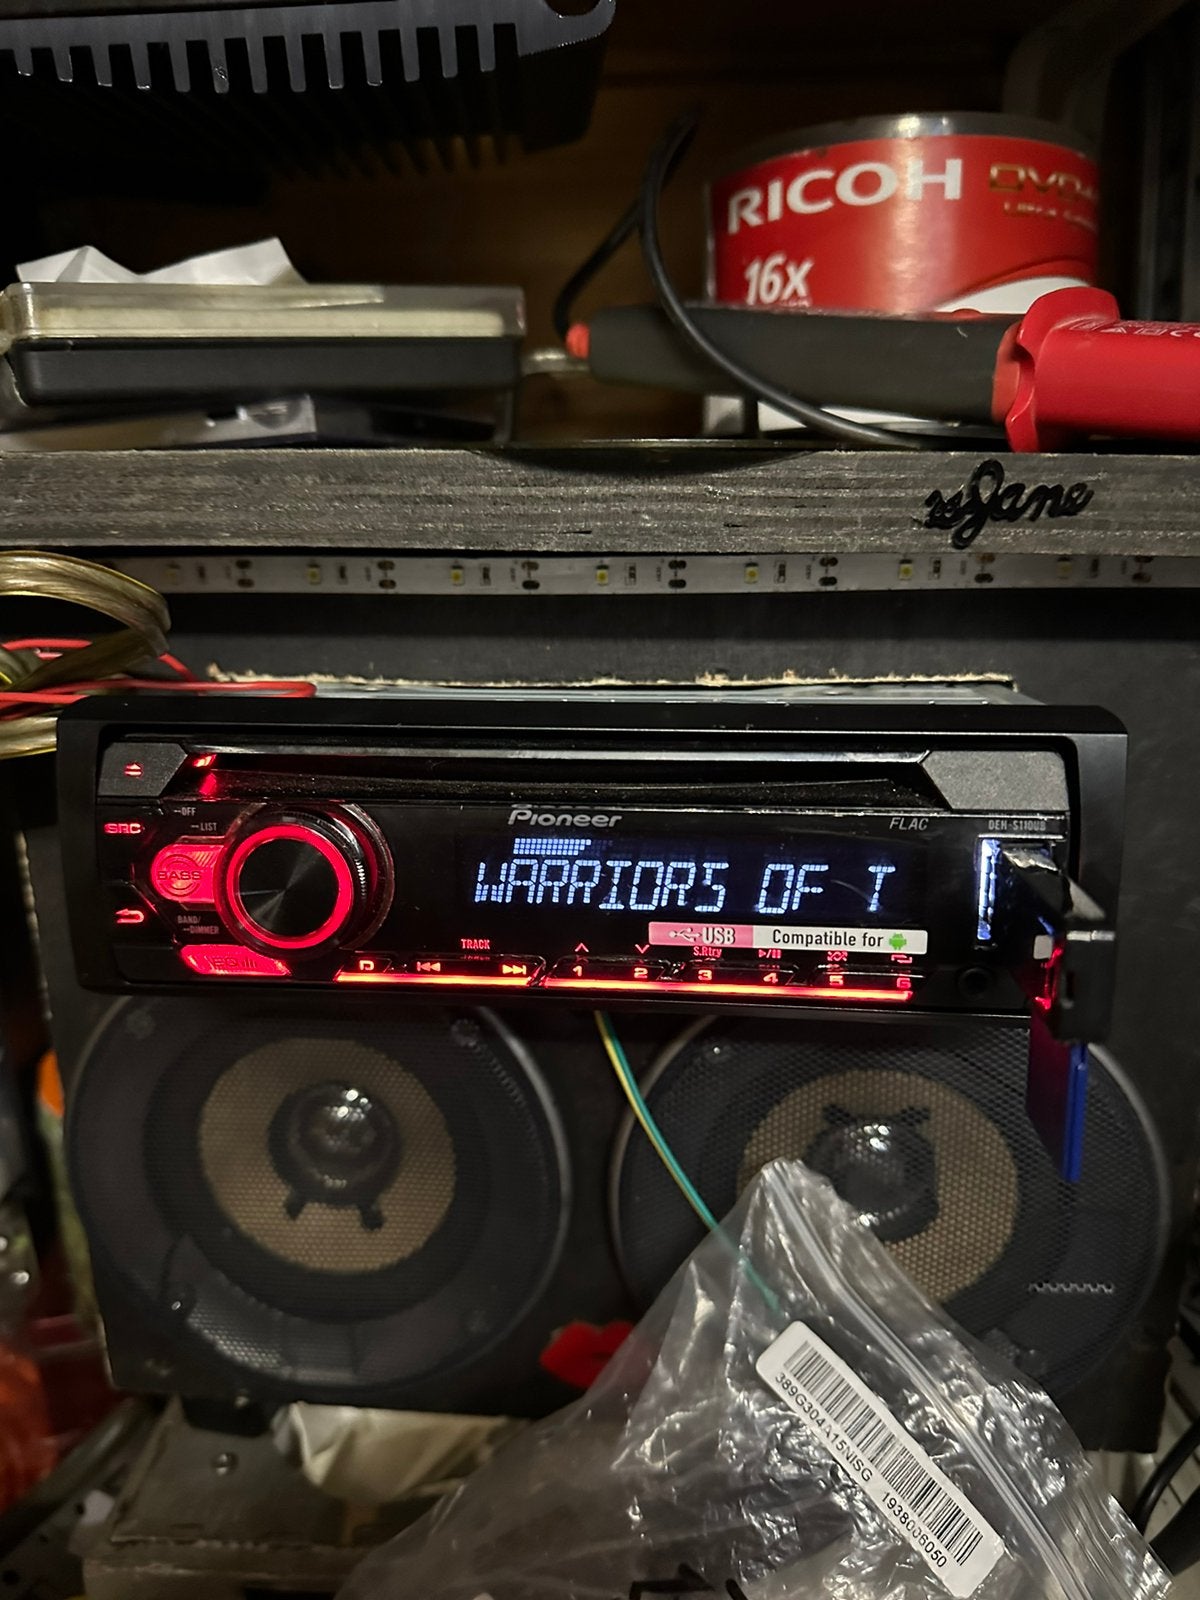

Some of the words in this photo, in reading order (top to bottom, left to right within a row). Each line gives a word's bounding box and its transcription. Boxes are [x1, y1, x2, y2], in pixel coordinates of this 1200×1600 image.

[727, 158, 963, 235] RICOH
[507, 808, 622, 829] Pioneer
[889, 817, 929, 831] FLAC
[103, 822, 142, 835] SRC
[200, 822, 217, 832] LIST
[157, 869, 201, 881] BASS
[474, 858, 729, 913] WARRIORS
[756, 862, 829, 914] OF
[866, 865, 896, 912] T
[702, 925, 736, 946] USB
[772, 928, 859, 948] Compatible
[861, 931, 884, 948] for
[460, 938, 490, 950] TRACK
[572, 965, 583, 977] 1
[633, 967, 649, 979] 2
[697, 969, 713, 981] 3
[763, 972, 779, 984] 4
[828, 975, 844, 986] 5
